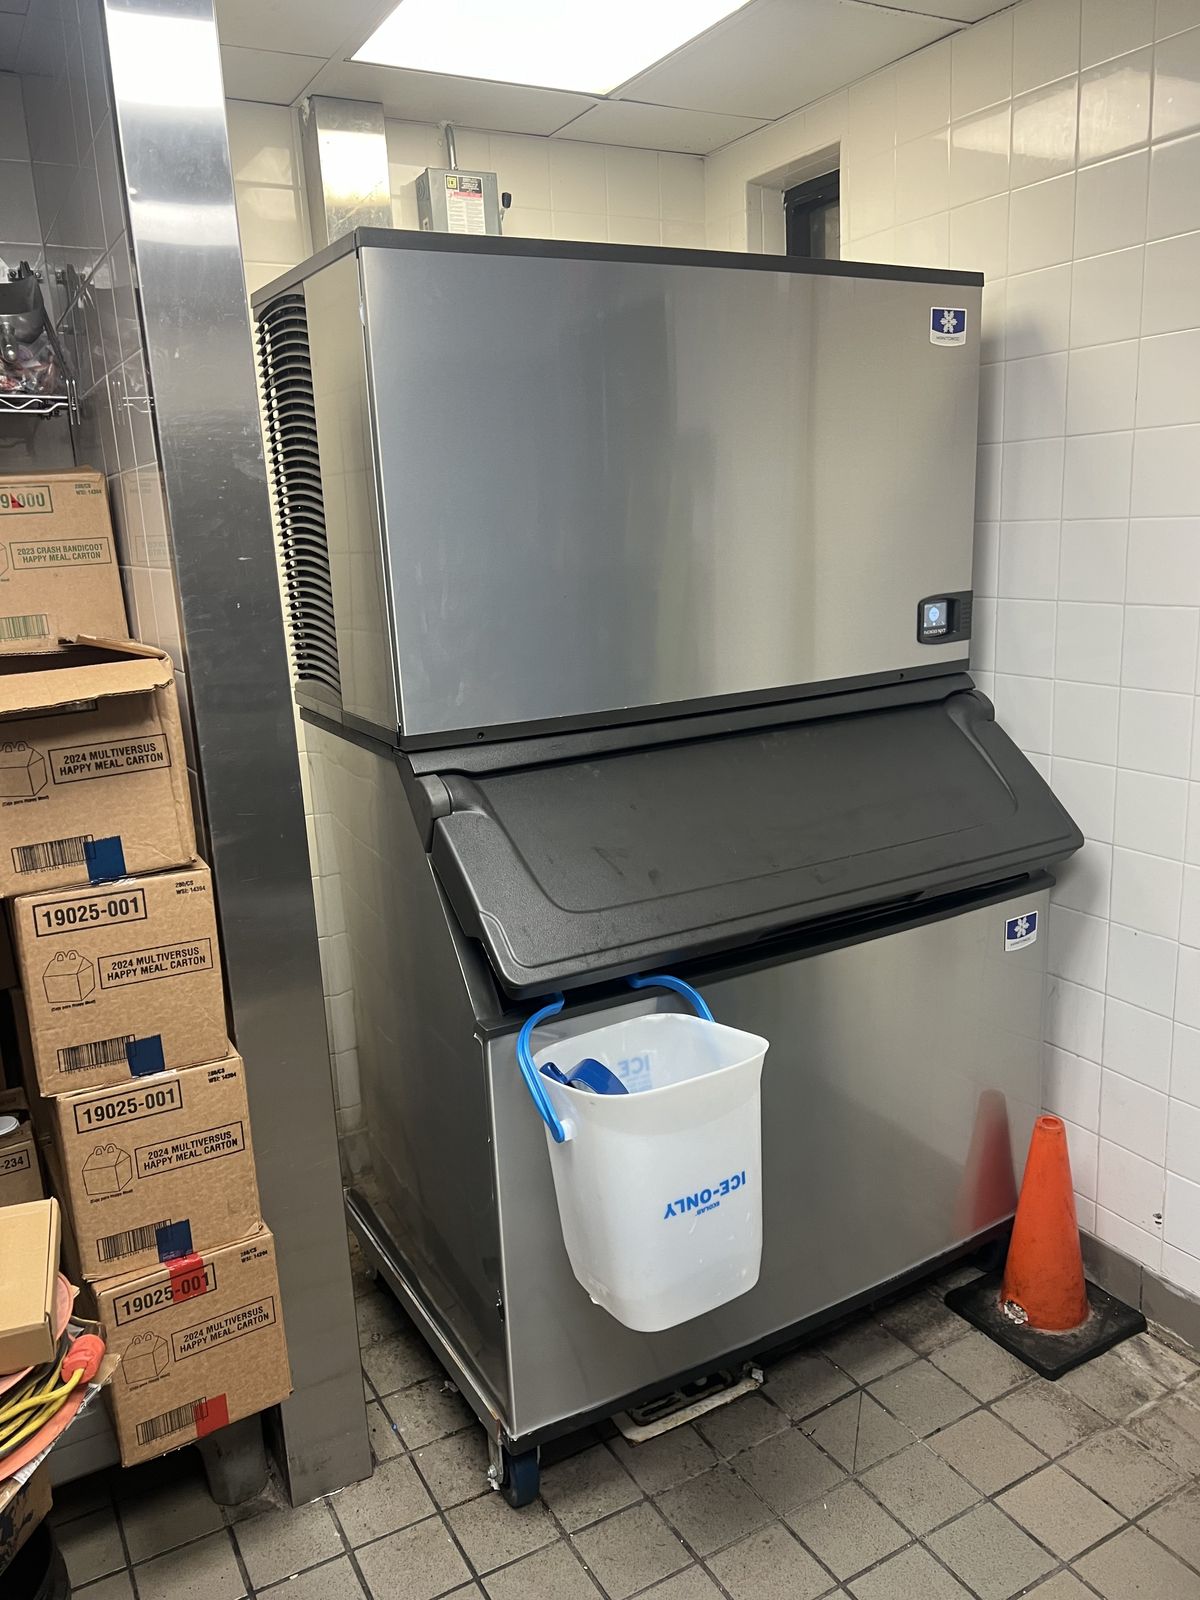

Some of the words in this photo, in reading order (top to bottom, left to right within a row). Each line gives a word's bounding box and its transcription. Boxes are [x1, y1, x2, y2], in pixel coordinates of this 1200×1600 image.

[22, 554, 47, 564] HAPPY
[72, 552, 101, 560] CARTON
[36, 545, 60, 555] CRASH
[63, 544, 103, 552] BANDICOOT
[59, 763, 92, 776] HAPPY
[126, 752, 163, 766] CARTON
[63, 752, 87, 765] 2024
[89, 743, 156, 761] MULTIVERSUS
[42, 896, 139, 928] 19025-001
[107, 967, 138, 982] HAPPY
[170, 955, 206, 970] CARTON
[112, 958, 134, 971] 2024
[136, 946, 200, 966] MULTIVERSUS
[83, 1088, 175, 1124] 19025-001
[143, 1156, 173, 1171] HAPPY
[204, 1138, 238, 1155] CARTON
[148, 1148, 169, 1160] 2024
[171, 1131, 232, 1154] MULTIVERSUS
[664, 1170, 746, 1220] ICE-ONLY
[122, 1272, 210, 1316] 19025-001
[180, 1337, 208, 1353] HAPPY
[237, 1312, 269, 1331] CARTON
[184, 1329, 204, 1342] 2024
[206, 1305, 264, 1333] MULTIVERSUS
